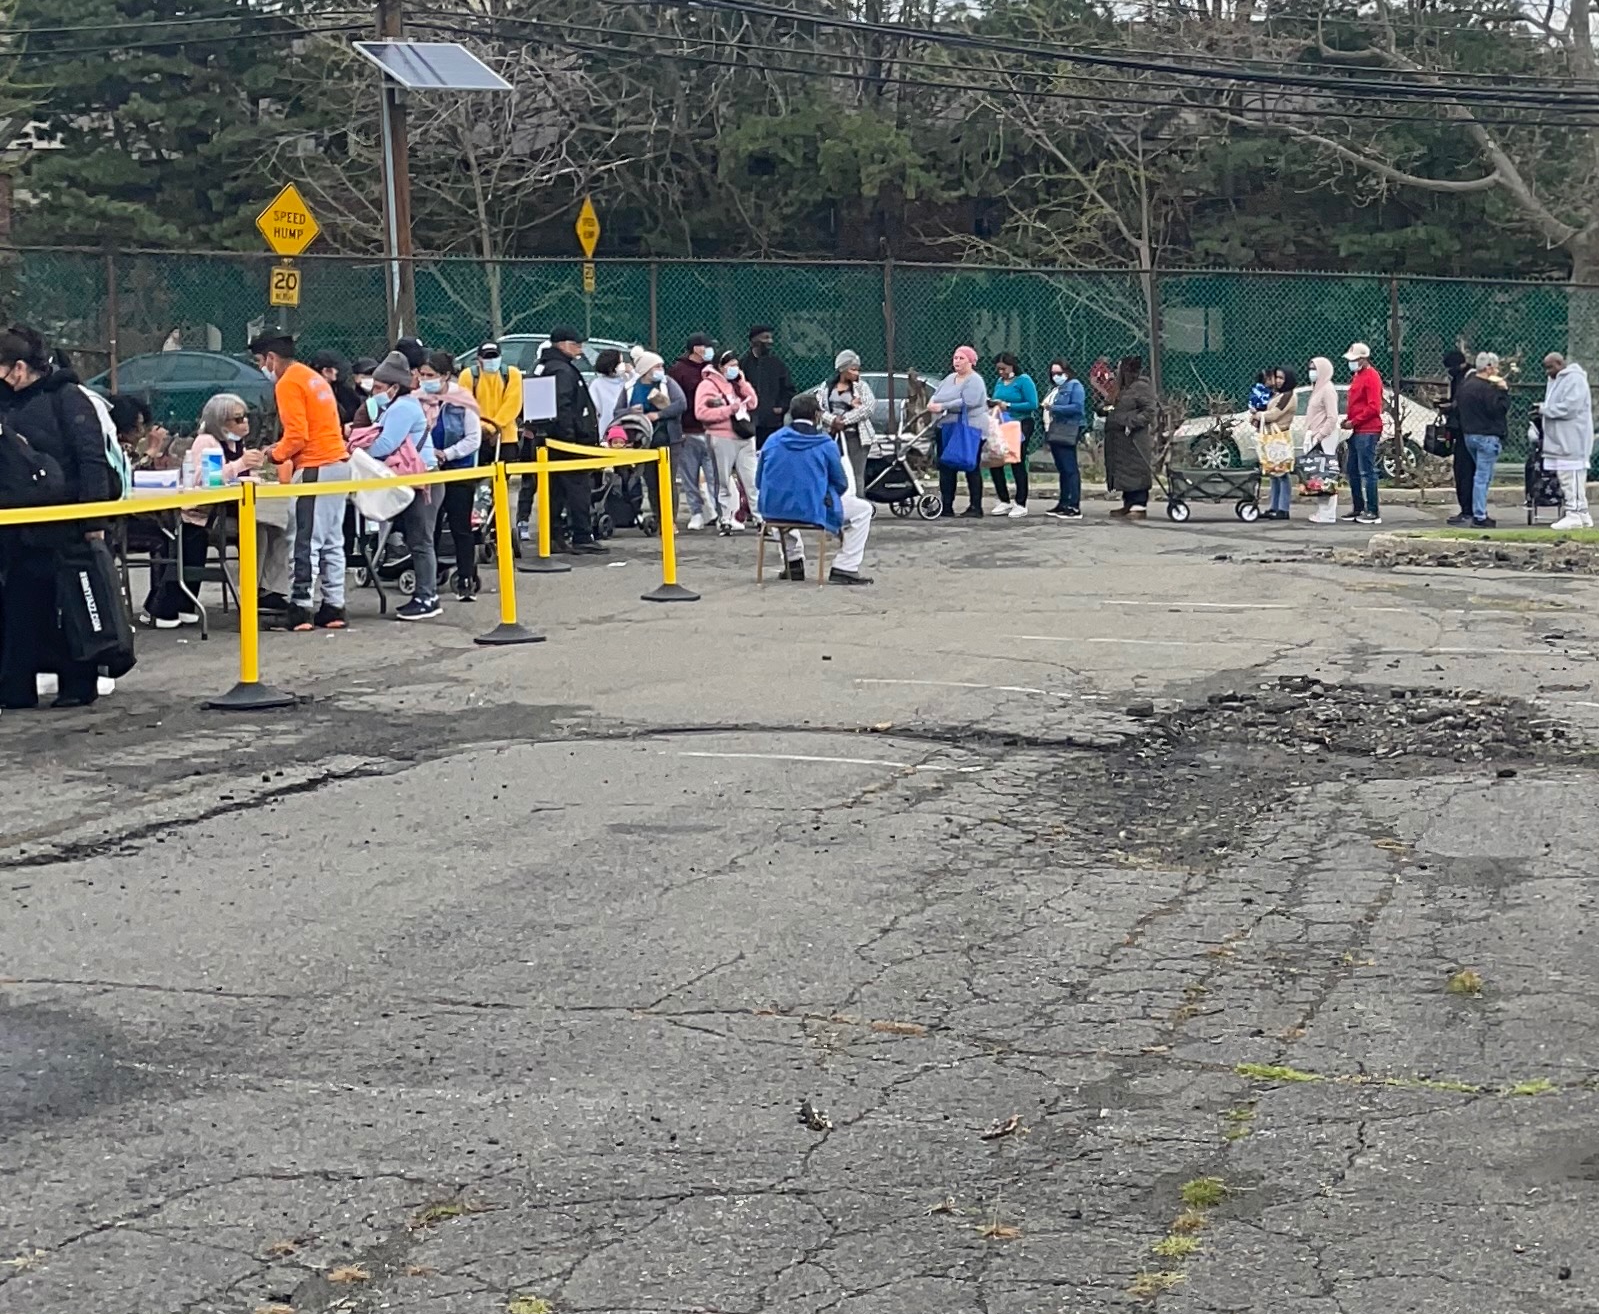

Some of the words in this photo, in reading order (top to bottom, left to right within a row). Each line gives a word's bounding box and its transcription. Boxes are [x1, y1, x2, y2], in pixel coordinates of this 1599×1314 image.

[274, 211, 306, 224] SPEED
[274, 227, 303, 240] HUMP
[275, 273, 297, 290] 20
